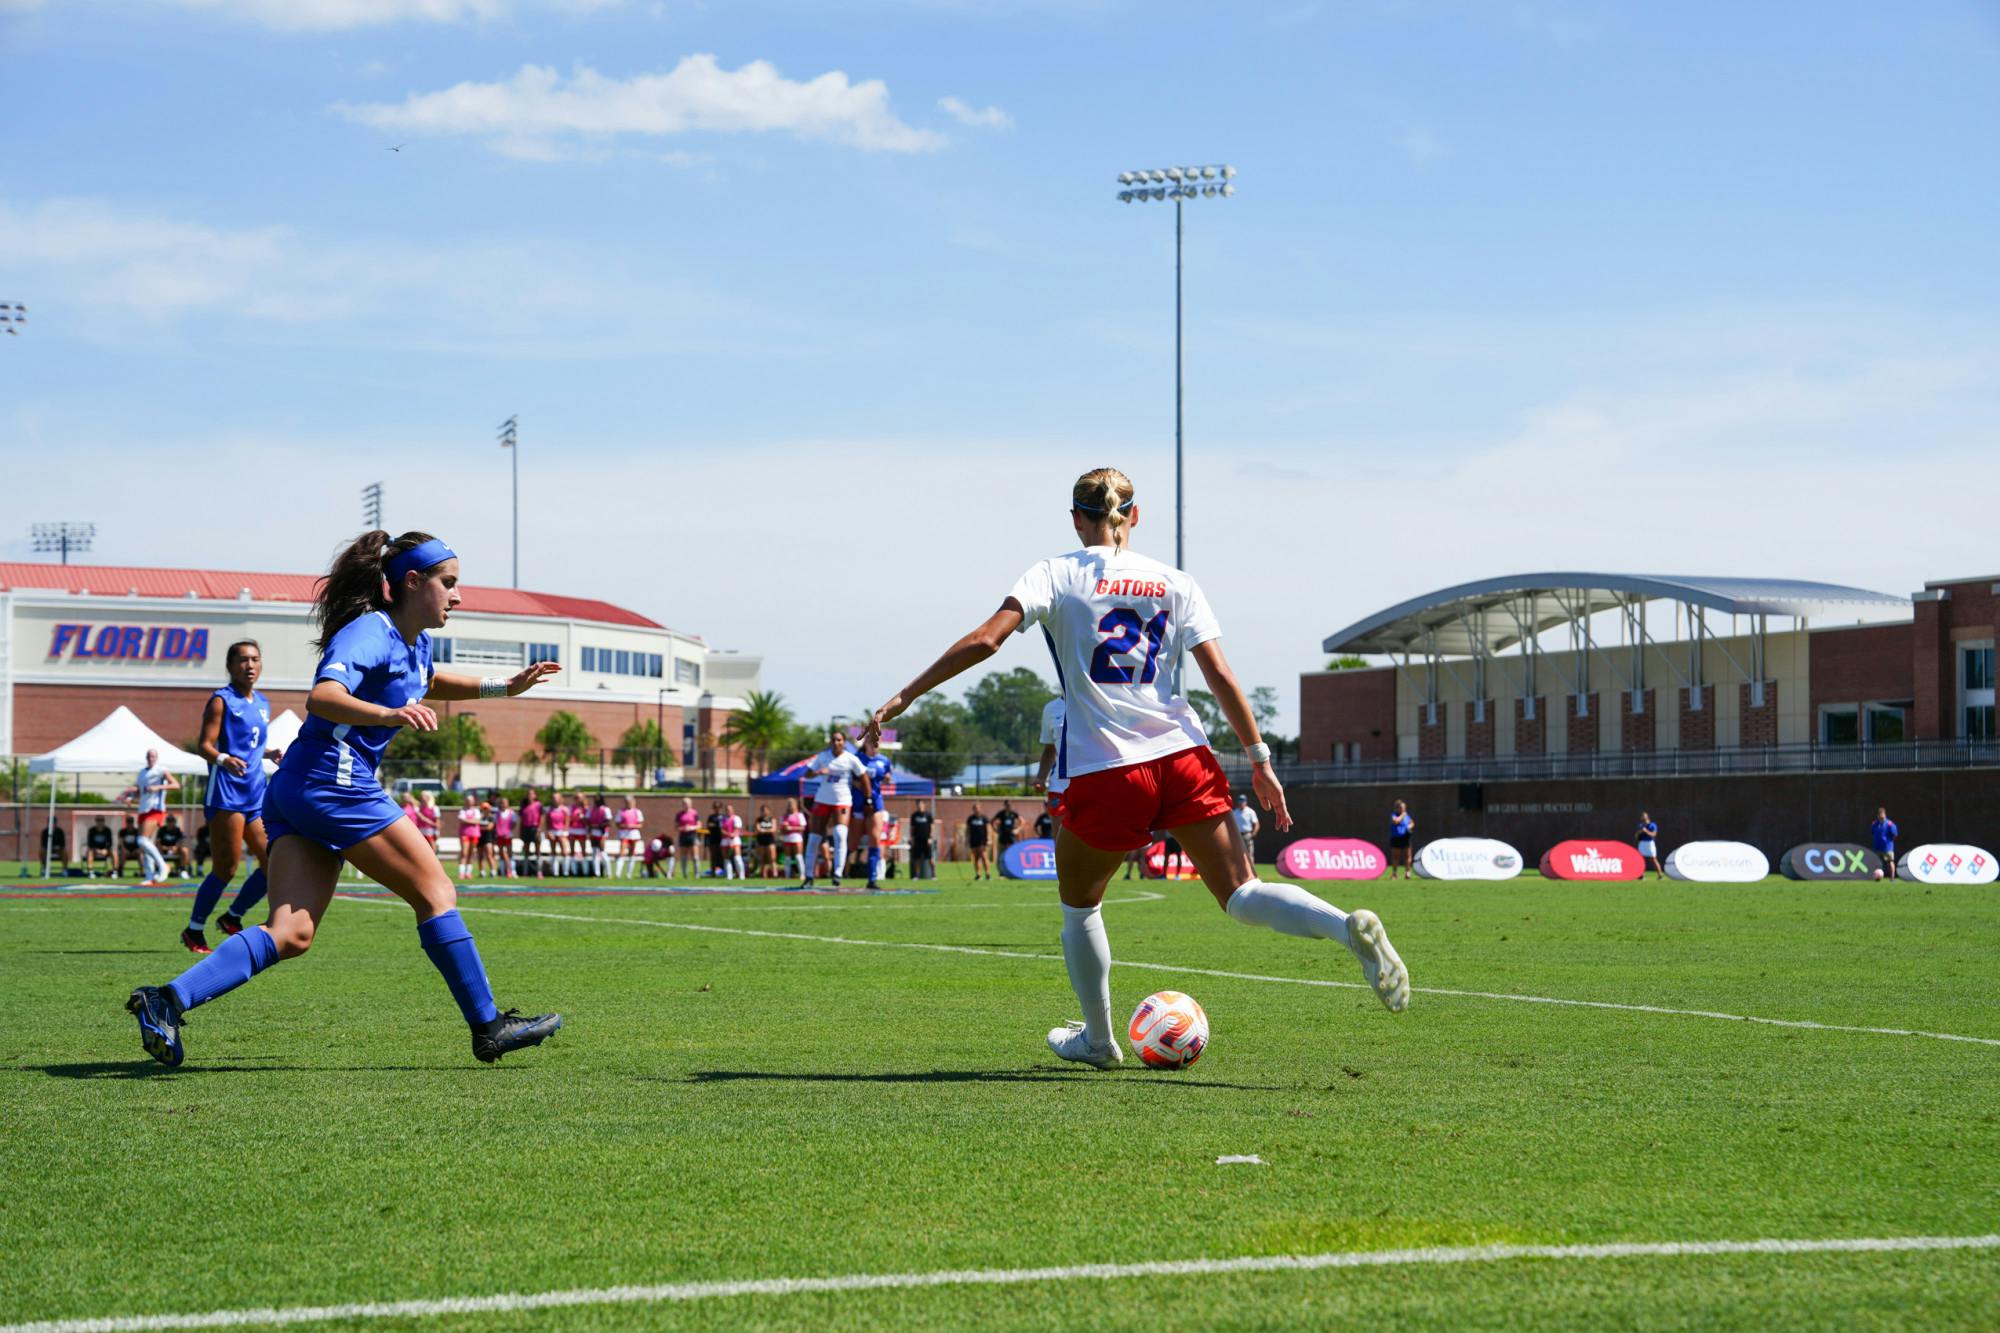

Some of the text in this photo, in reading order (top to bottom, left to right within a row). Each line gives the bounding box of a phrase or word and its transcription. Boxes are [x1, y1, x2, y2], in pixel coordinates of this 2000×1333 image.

[1095, 578, 1167, 598] GATORS
[49, 624, 209, 661] FLORIDA
[1089, 607, 1170, 685] 21
[250, 726, 260, 749] 3
[1570, 853, 1622, 874] Wawa
[1804, 848, 1869, 873] COX
